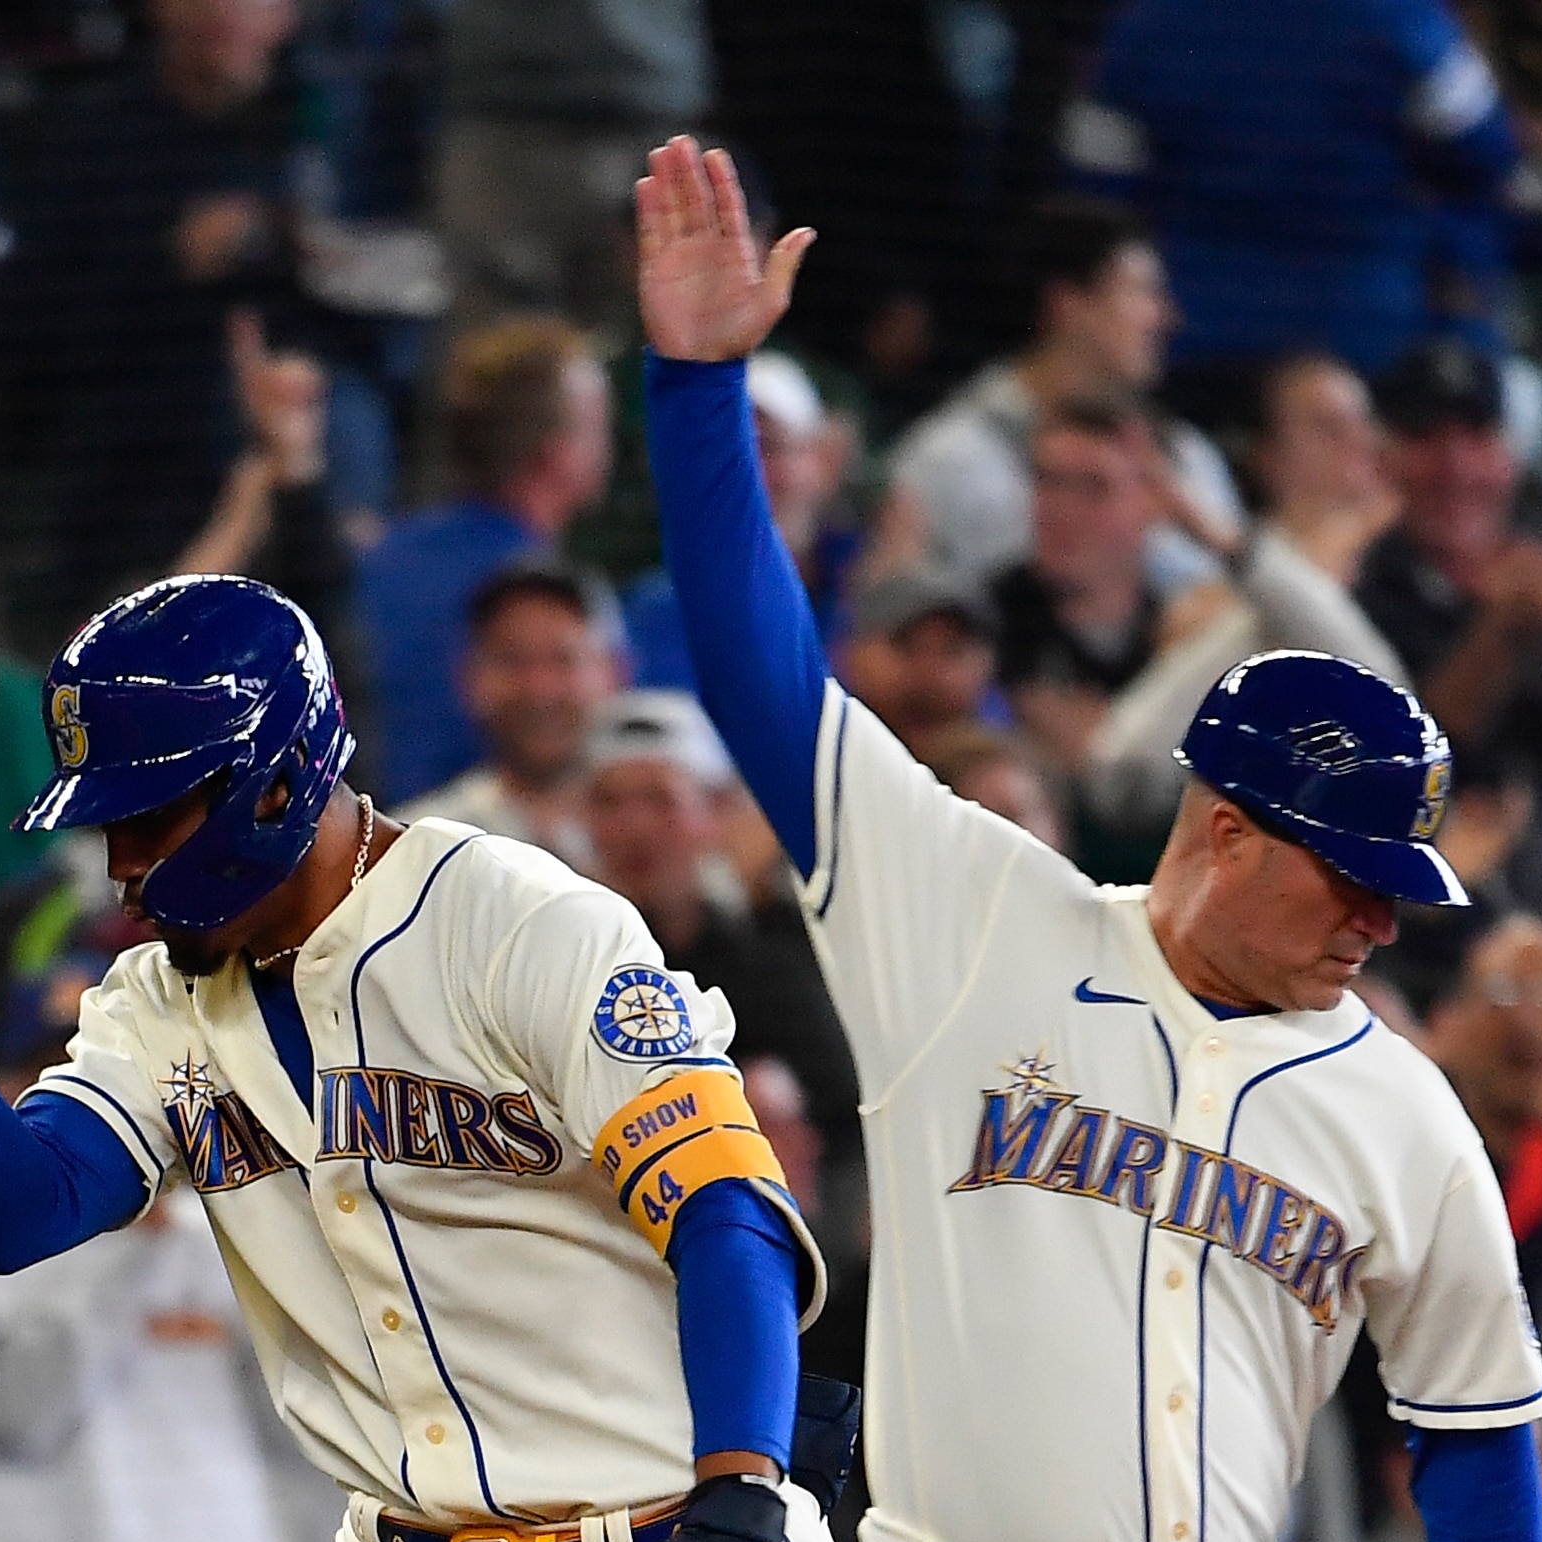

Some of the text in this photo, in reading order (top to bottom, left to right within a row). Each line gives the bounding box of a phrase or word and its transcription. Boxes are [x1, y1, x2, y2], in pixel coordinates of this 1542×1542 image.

[162, 1066, 563, 1194] MAINERS
[622, 1092, 698, 1148] SHOW
[641, 1169, 684, 1226] 44
